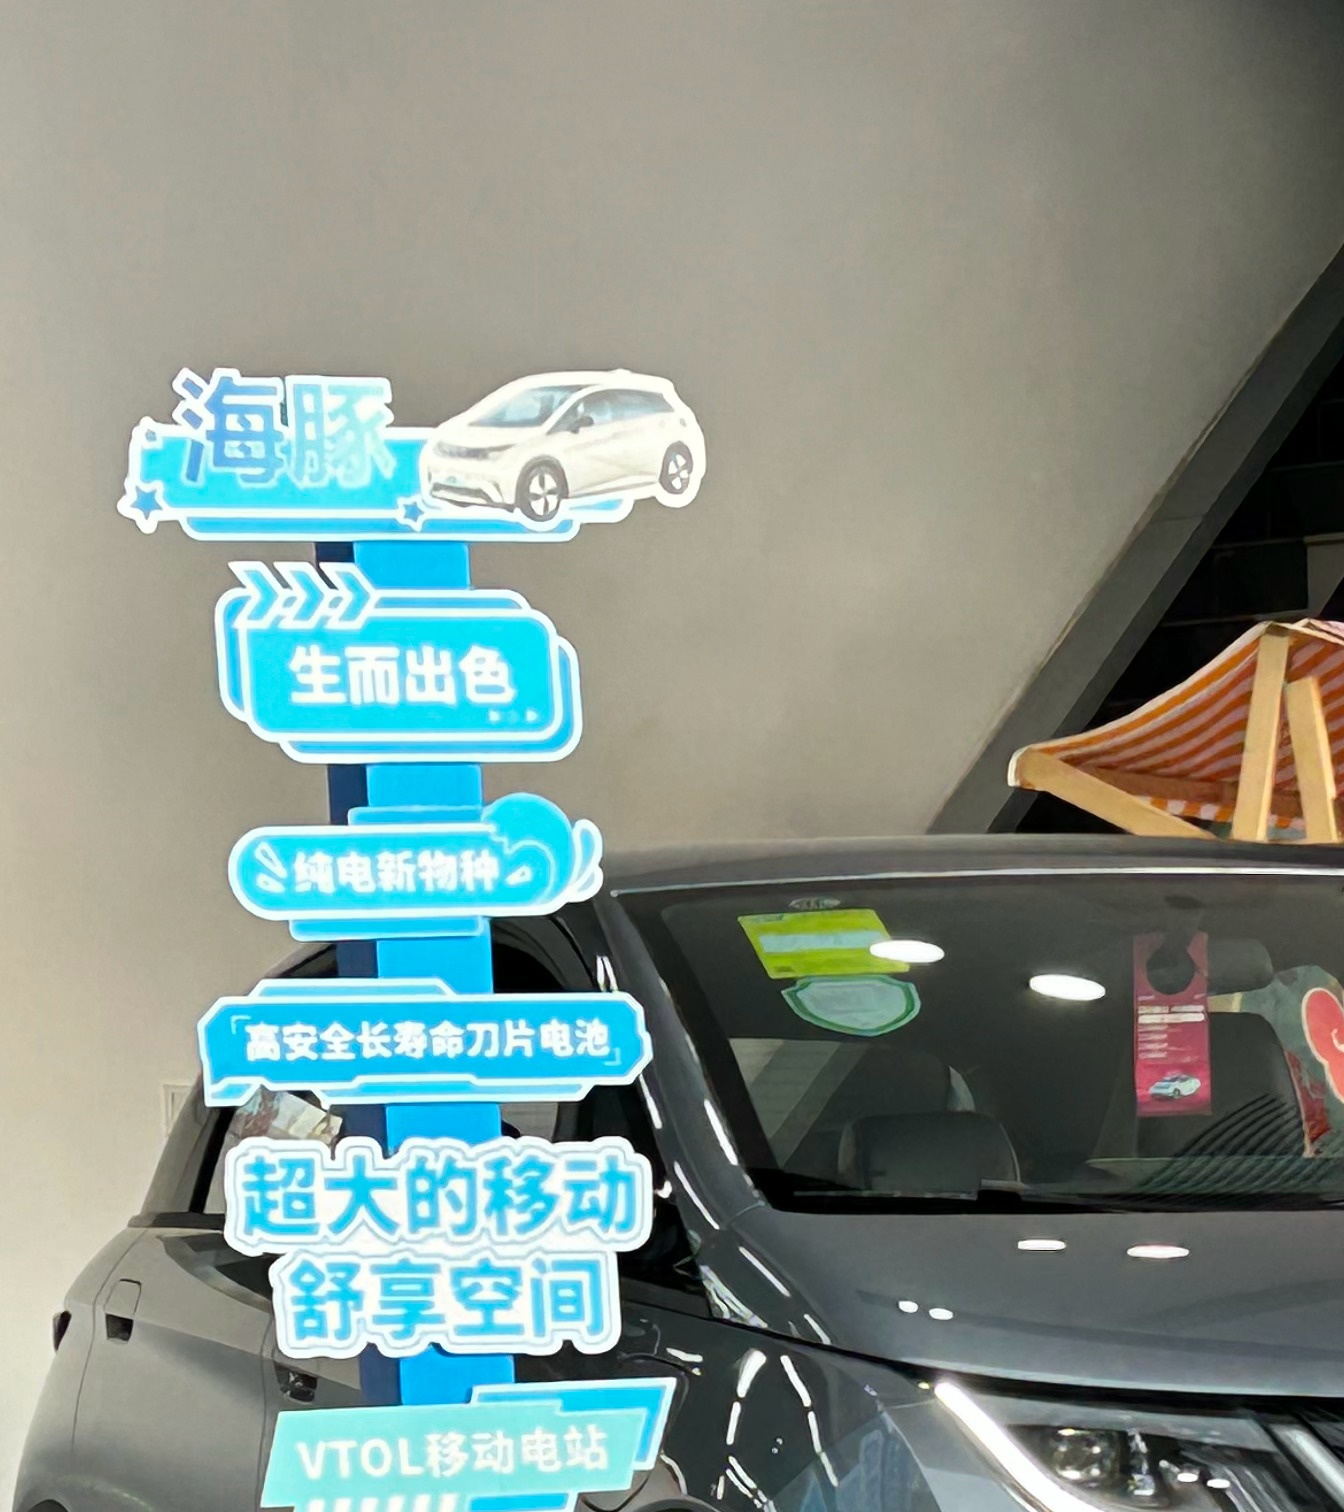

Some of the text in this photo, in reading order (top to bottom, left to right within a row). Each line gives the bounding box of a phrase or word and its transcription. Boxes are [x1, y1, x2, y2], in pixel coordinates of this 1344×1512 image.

[179, 374, 396, 487] 海豚
[289, 644, 516, 704] 生而出色
[293, 850, 499, 895] 纯电新物种
[244, 1019, 612, 1061] 高安全长寿命刀片电池
[241, 1154, 637, 1237] 超大的移动
[288, 1258, 604, 1341] 舒享空间
[297, 1424, 608, 1480] VTOL移动电站
